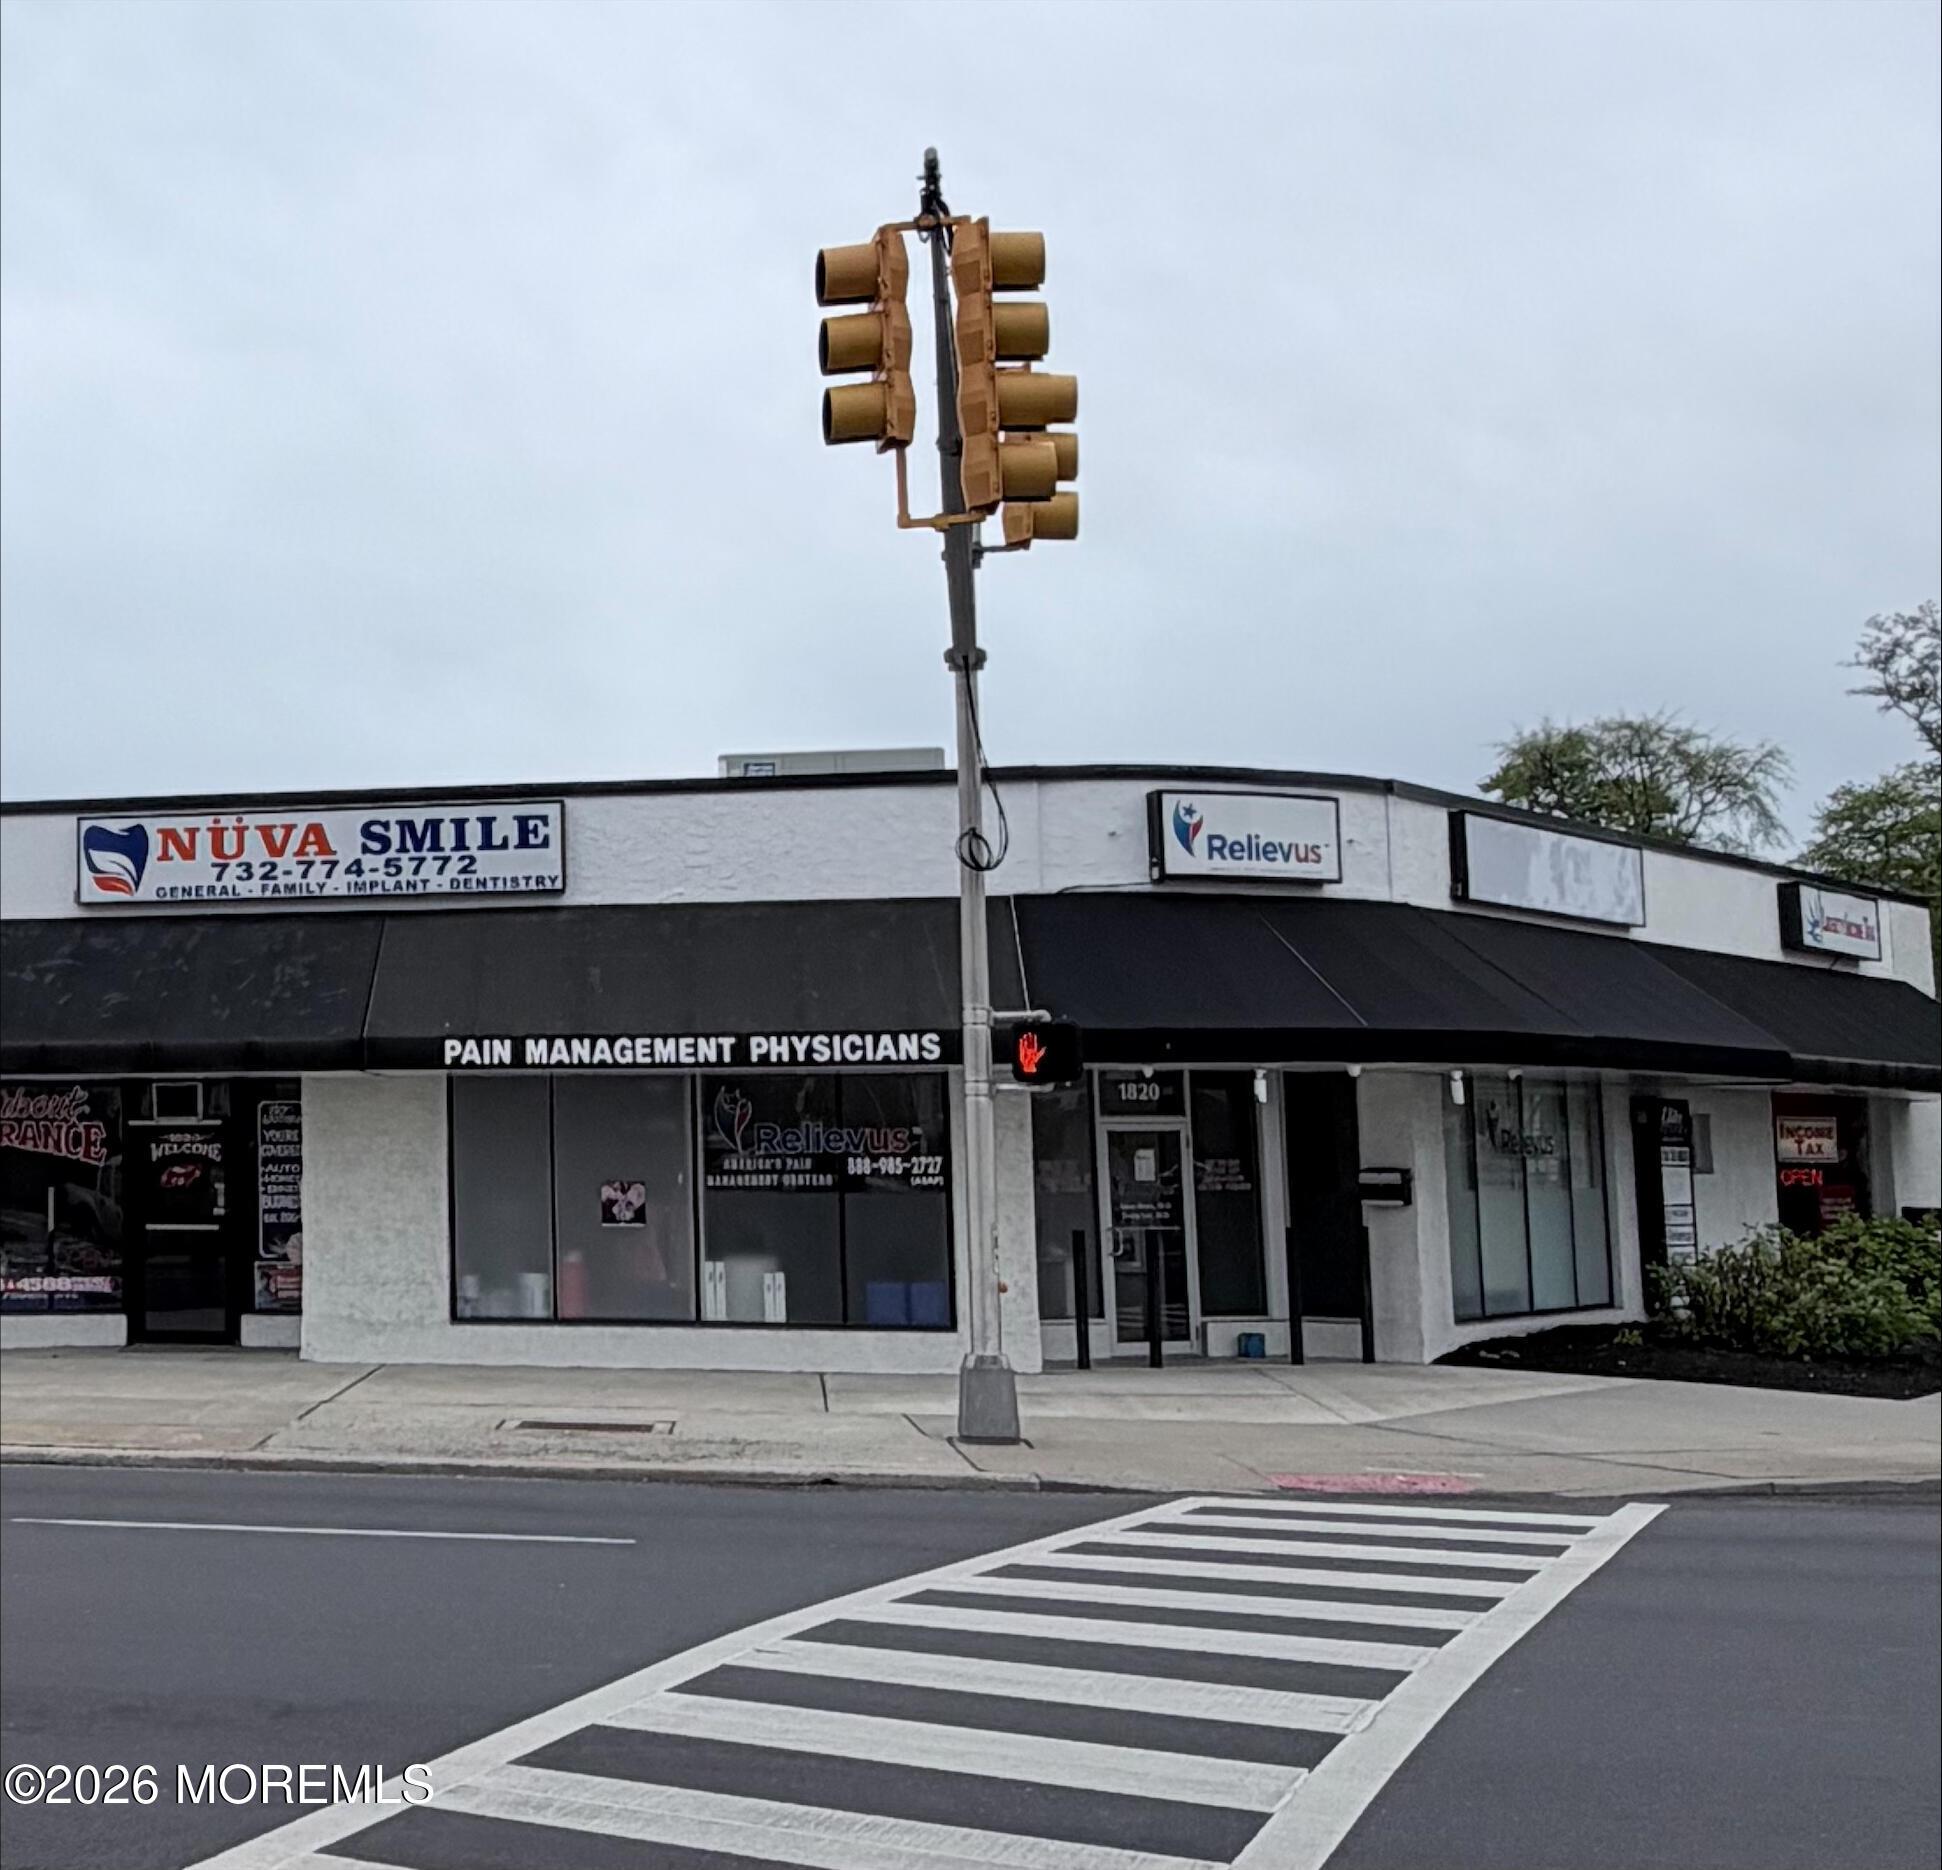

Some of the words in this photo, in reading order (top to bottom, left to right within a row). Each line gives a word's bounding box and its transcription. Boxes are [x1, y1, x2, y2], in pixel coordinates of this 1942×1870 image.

[156, 816, 337, 862] NÜVA
[360, 814, 551, 856] SMILE
[1206, 833, 1322, 864] Relievus
[210, 855, 478, 883] 732-774-5772
[155, 883, 242, 899] GENERAL
[260, 881, 327, 897] FAMILY
[346, 878, 430, 894] IMPLANT
[449, 874, 560, 891] DENTISTRY
[444, 1038, 512, 1066] PAIN
[525, 1036, 736, 1064] MANAGEMENT
[749, 1033, 942, 1063] PHYSICIANS
[1118, 1083, 1160, 1101] 1820
[754, 1121, 911, 1155] Relievus
[150, 1143, 222, 1162] WELCOME
[847, 1156, 943, 1176] 888-985-2727
[1780, 1168, 1824, 1186] OPEN
